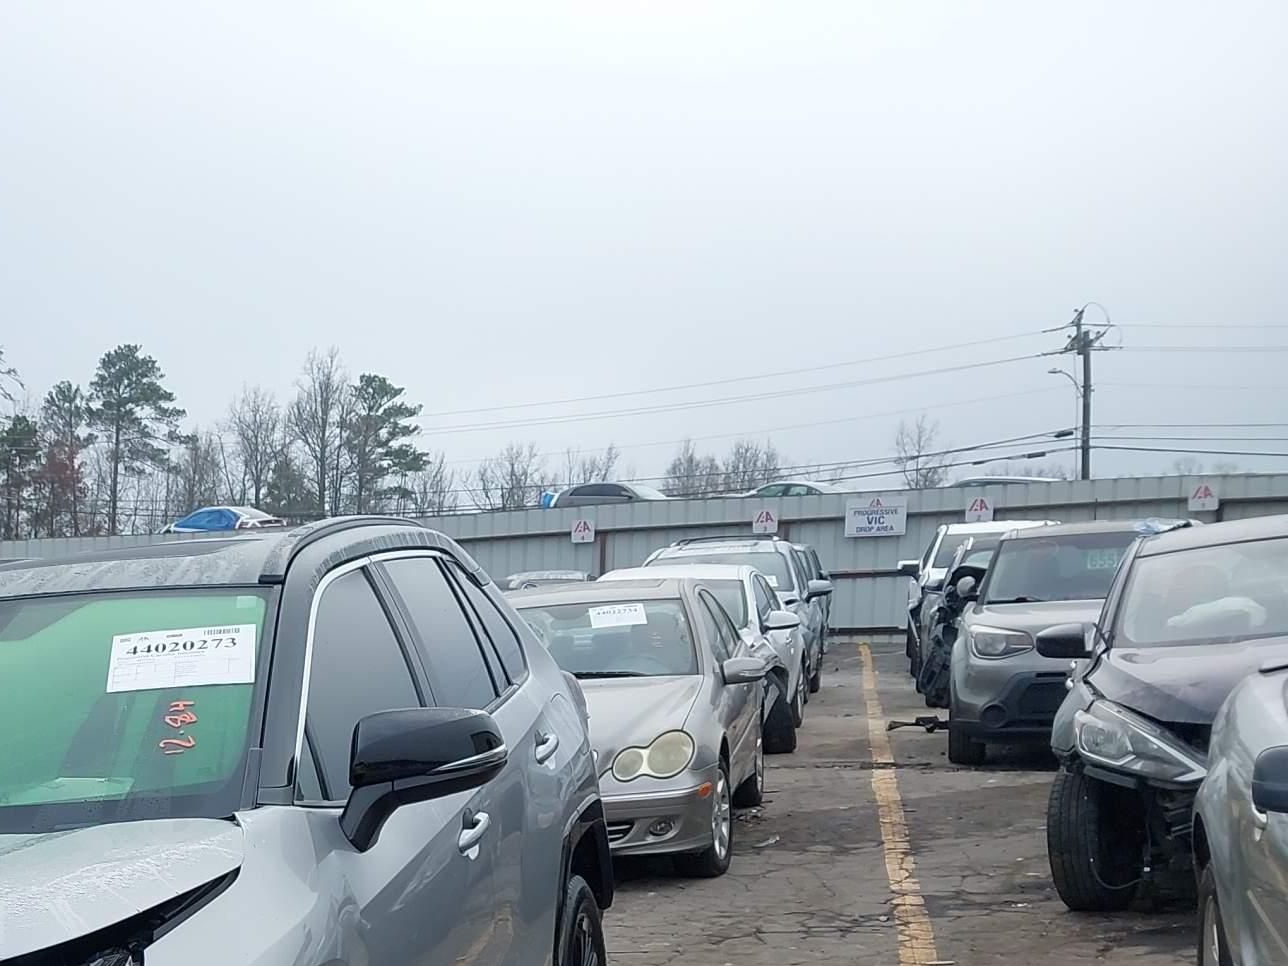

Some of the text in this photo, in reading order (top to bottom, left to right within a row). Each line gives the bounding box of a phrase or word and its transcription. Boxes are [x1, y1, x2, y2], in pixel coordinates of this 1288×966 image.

[854, 508, 898, 517] PROGRESSIVE
[866, 516, 885, 525] VIC
[126, 637, 238, 655] 44020273
